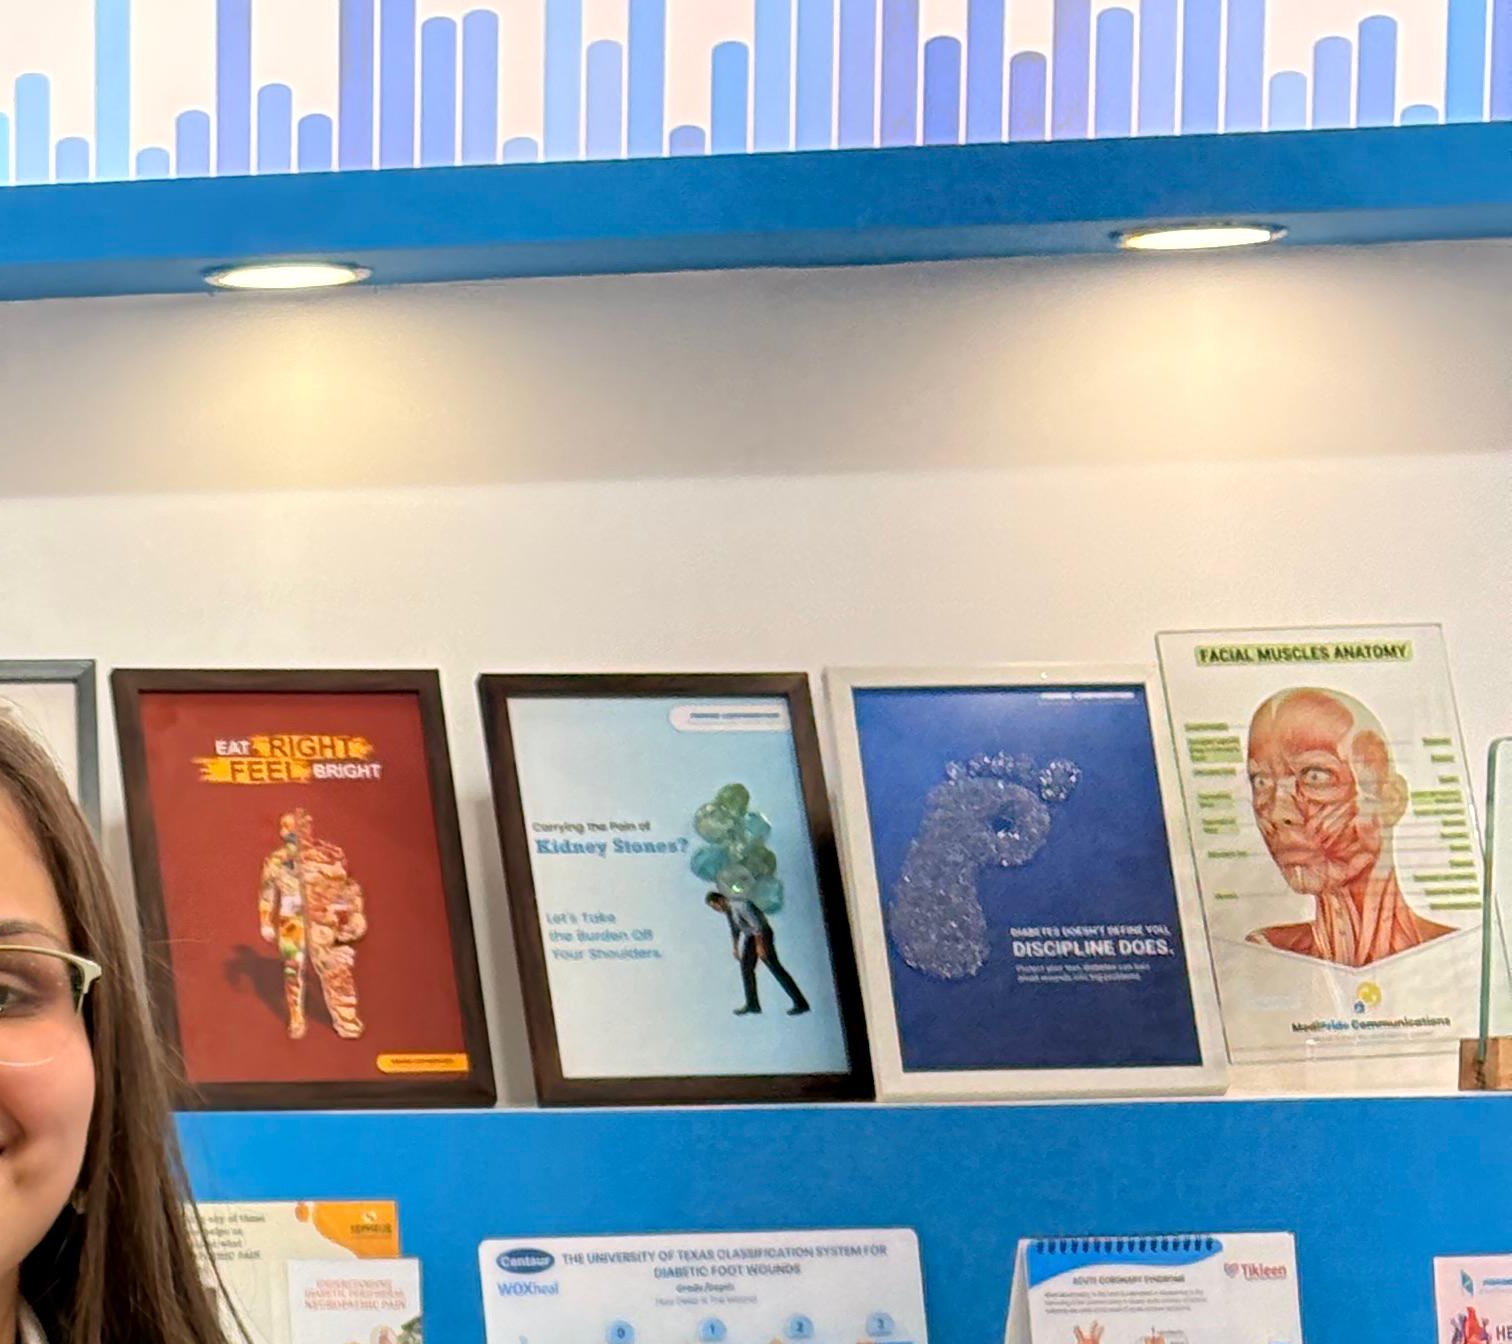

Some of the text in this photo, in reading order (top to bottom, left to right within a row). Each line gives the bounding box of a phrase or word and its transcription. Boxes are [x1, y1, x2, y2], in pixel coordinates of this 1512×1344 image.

[1199, 644, 1407, 663] FACIAL MUSCLES ANATOMY
[215, 737, 353, 759] EAT RIGHT
[230, 760, 382, 782] FEEL BRIGHT
[532, 822, 584, 834] Carrying
[535, 837, 689, 858] Kidney Stones?
[1013, 939, 1176, 958] DISCIPLINE DOES.
[1351, 1014, 1451, 1031] Communications
[499, 1255, 551, 1268] Centaur
[562, 1244, 888, 1265] THE UNIVERSITY OF TEXAS CLASSIFICATION SYSTEM FOR
[654, 1264, 801, 1278] DIABETIC FOOT WOUNDS
[498, 1282, 559, 1297] WOXheal
